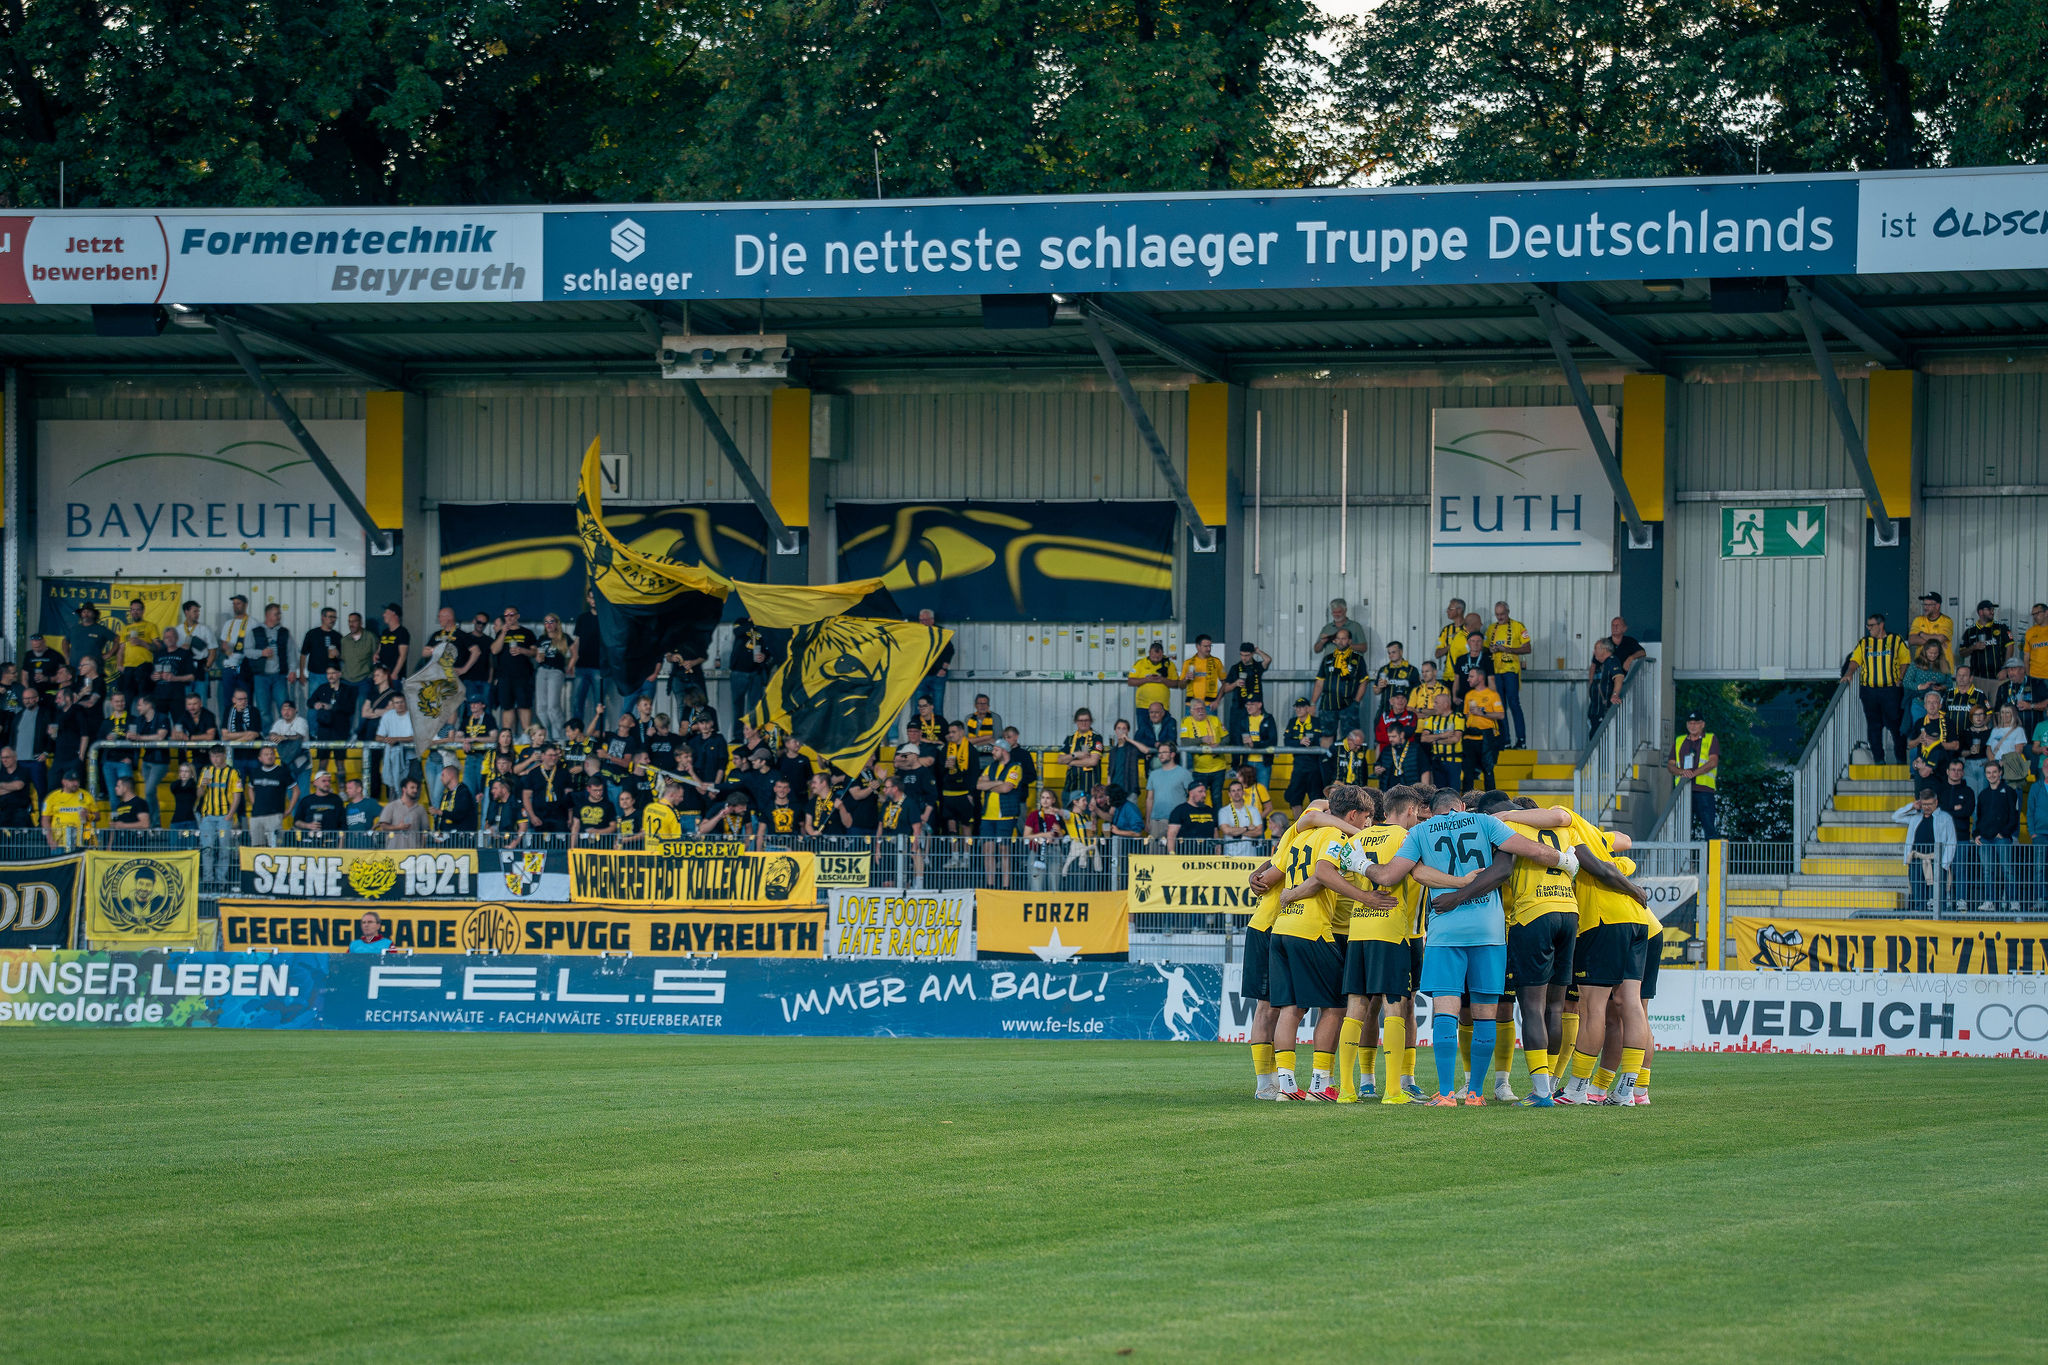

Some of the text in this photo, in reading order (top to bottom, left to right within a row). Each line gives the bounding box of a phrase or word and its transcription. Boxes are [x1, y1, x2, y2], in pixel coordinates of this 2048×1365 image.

[180, 223, 498, 256] Formentechnik
[1881, 211, 1917, 238] ist
[65, 236, 124, 253] Jetzt
[734, 206, 1834, 278] Die netteste schlaeger Truppe Deutschlands
[32, 264, 158, 281] bewerben!
[331, 262, 526, 296] Bayreuth
[562, 267, 693, 297] schlaeger
[66, 502, 337, 552] BAYREUTH
[1439, 494, 1582, 532] EUTH
[50, 586, 178, 601] ALTSTADT KULT
[662, 842, 740, 857] SUPCREW
[253, 853, 470, 896] SZENE 1921
[820, 857, 861, 876] USK
[1182, 861, 1256, 871] OLDSCHDOD
[838, 895, 963, 928] LOVE FOOTBALL
[1023, 902, 1089, 923] FORZA
[525, 921, 818, 951] SPVGG BAYREUTH
[839, 925, 959, 957] HATE RACISM
[1952, 931, 2048, 975] ZÄH
[2, 962, 299, 997] UNSER LEBEN.
[1701, 973, 1760, 990] Immer
[1765, 972, 1780, 989] in
[1786, 973, 1893, 996] Bewegung.
[1901, 975, 1968, 997] Always
[1975, 979, 2001, 994] on
[2008, 977, 2037, 995] the
[781, 972, 1109, 1023] IMMER AM BALL!
[365, 1009, 485, 1024] RECHTSANWÄLTE
[499, 1010, 601, 1025] FACHANWÄLTE
[615, 1013, 723, 1027] STEUERBERATER
[1002, 1016, 1104, 1034] www.fe-ls.de
